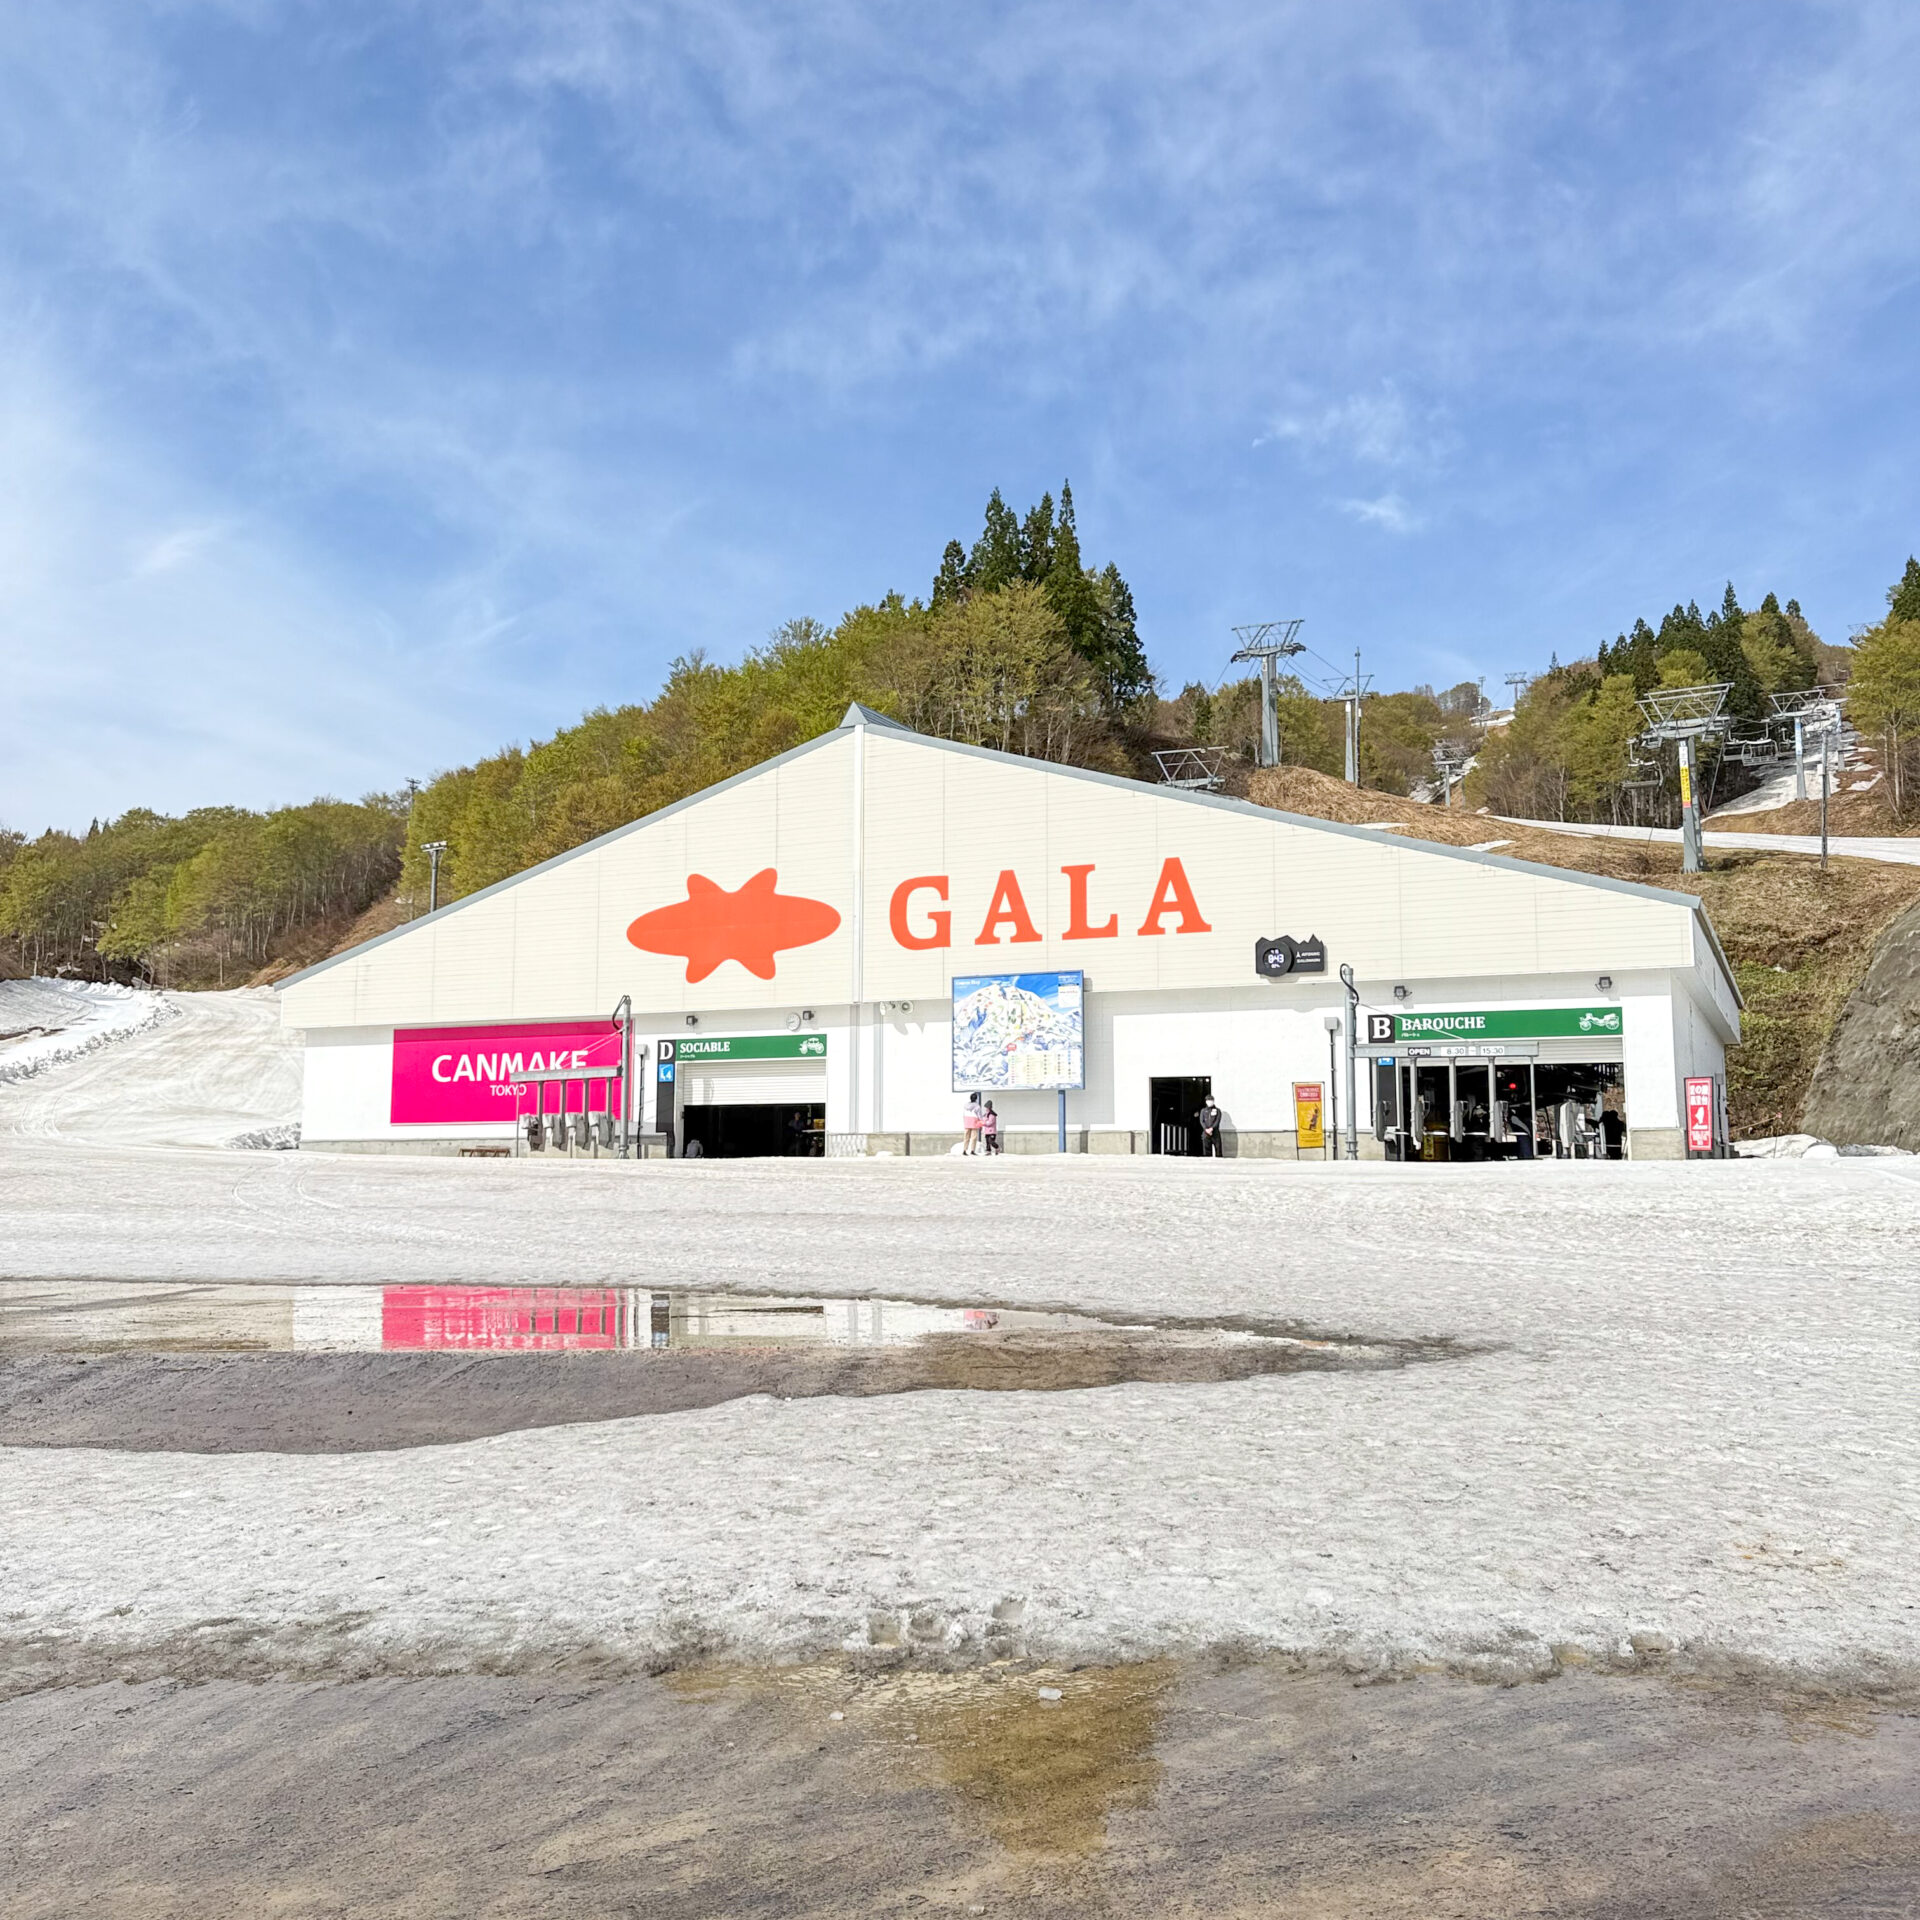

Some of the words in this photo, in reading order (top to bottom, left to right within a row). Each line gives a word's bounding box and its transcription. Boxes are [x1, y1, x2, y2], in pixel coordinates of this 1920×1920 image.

[888, 856, 1213, 951] GALA
[1372, 1017, 1391, 1039] B
[1401, 1016, 1486, 1031] BAROUCHE
[659, 1041, 674, 1060] D
[679, 1041, 731, 1054] SOCIABLE
[1408, 1048, 1431, 1056] OPEN
[431, 1050, 589, 1083] CANMAKE
[490, 1083, 527, 1096] TOKYO
